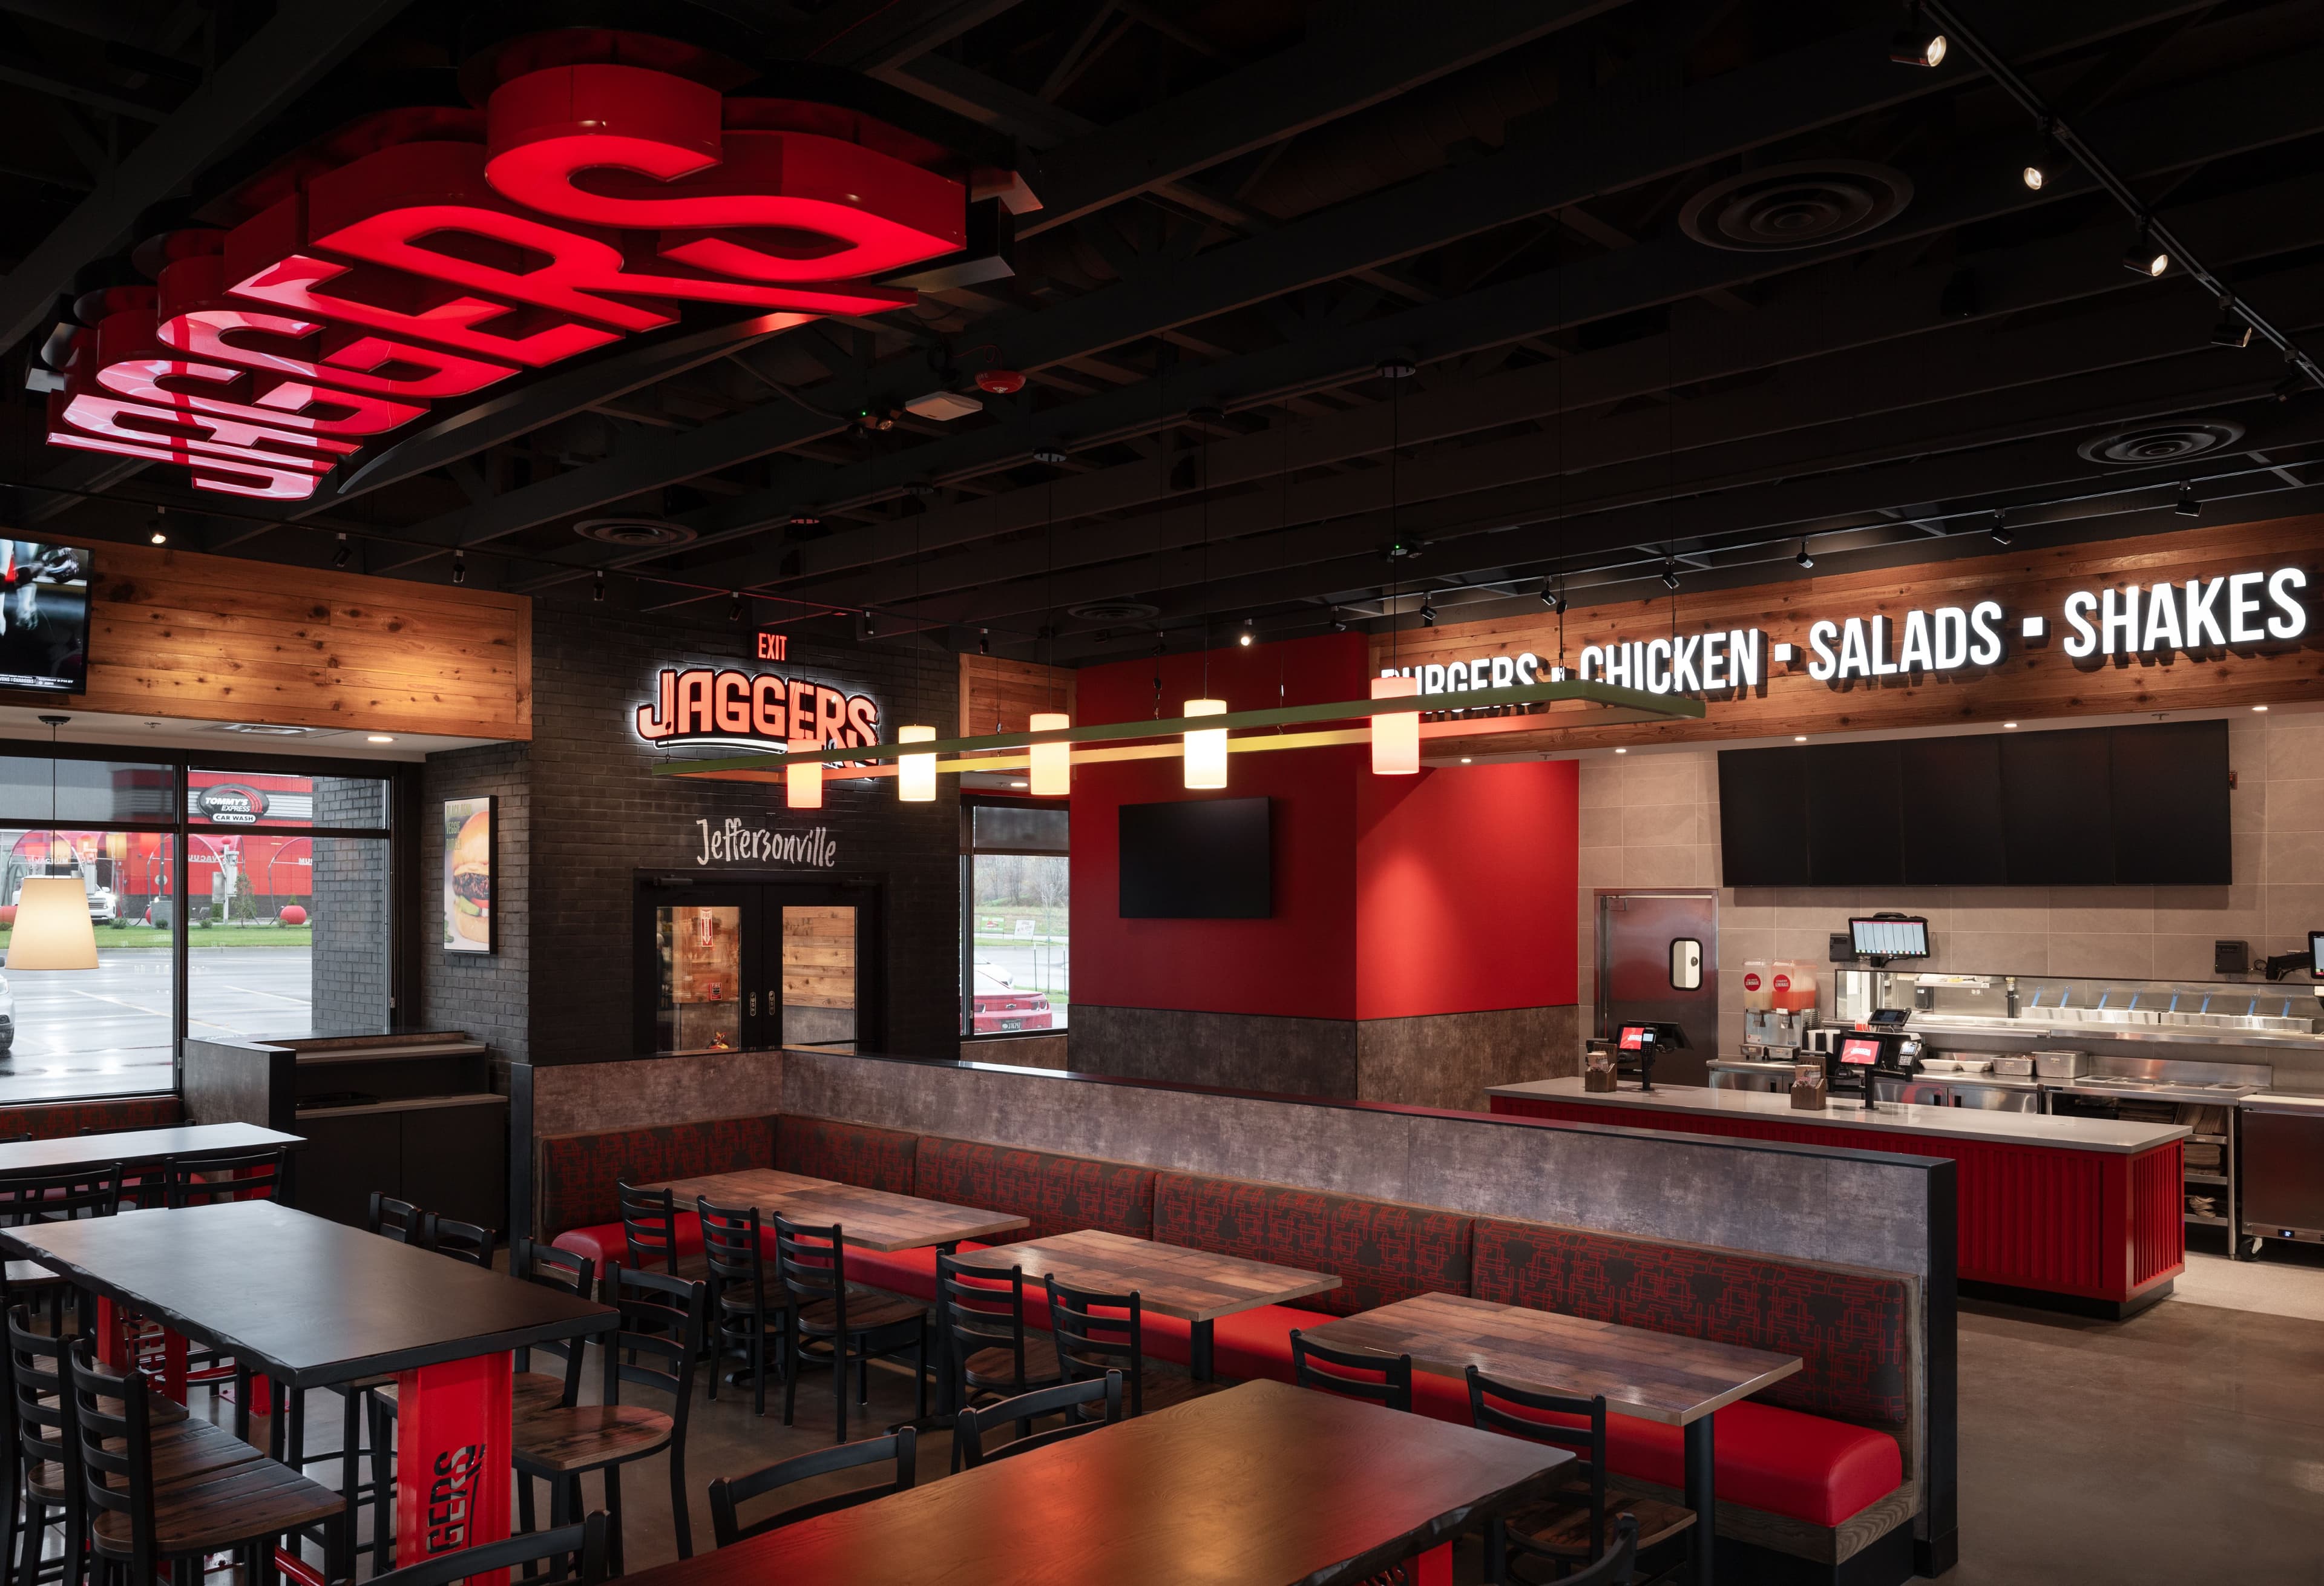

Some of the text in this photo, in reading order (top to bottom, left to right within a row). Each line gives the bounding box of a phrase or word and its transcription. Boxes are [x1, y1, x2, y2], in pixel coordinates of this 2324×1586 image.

[46, 121, 966, 501] JAGGERS
[758, 633, 787, 661] EXIT
[1381, 568, 2306, 712] RGERS CHICKEN SALADS SHAKES
[638, 671, 879, 768] JAGGERS
[205, 797, 249, 806] TOMMY'S
[447, 821, 461, 834] VEGGIE
[696, 818, 836, 867] Jeffersonville
